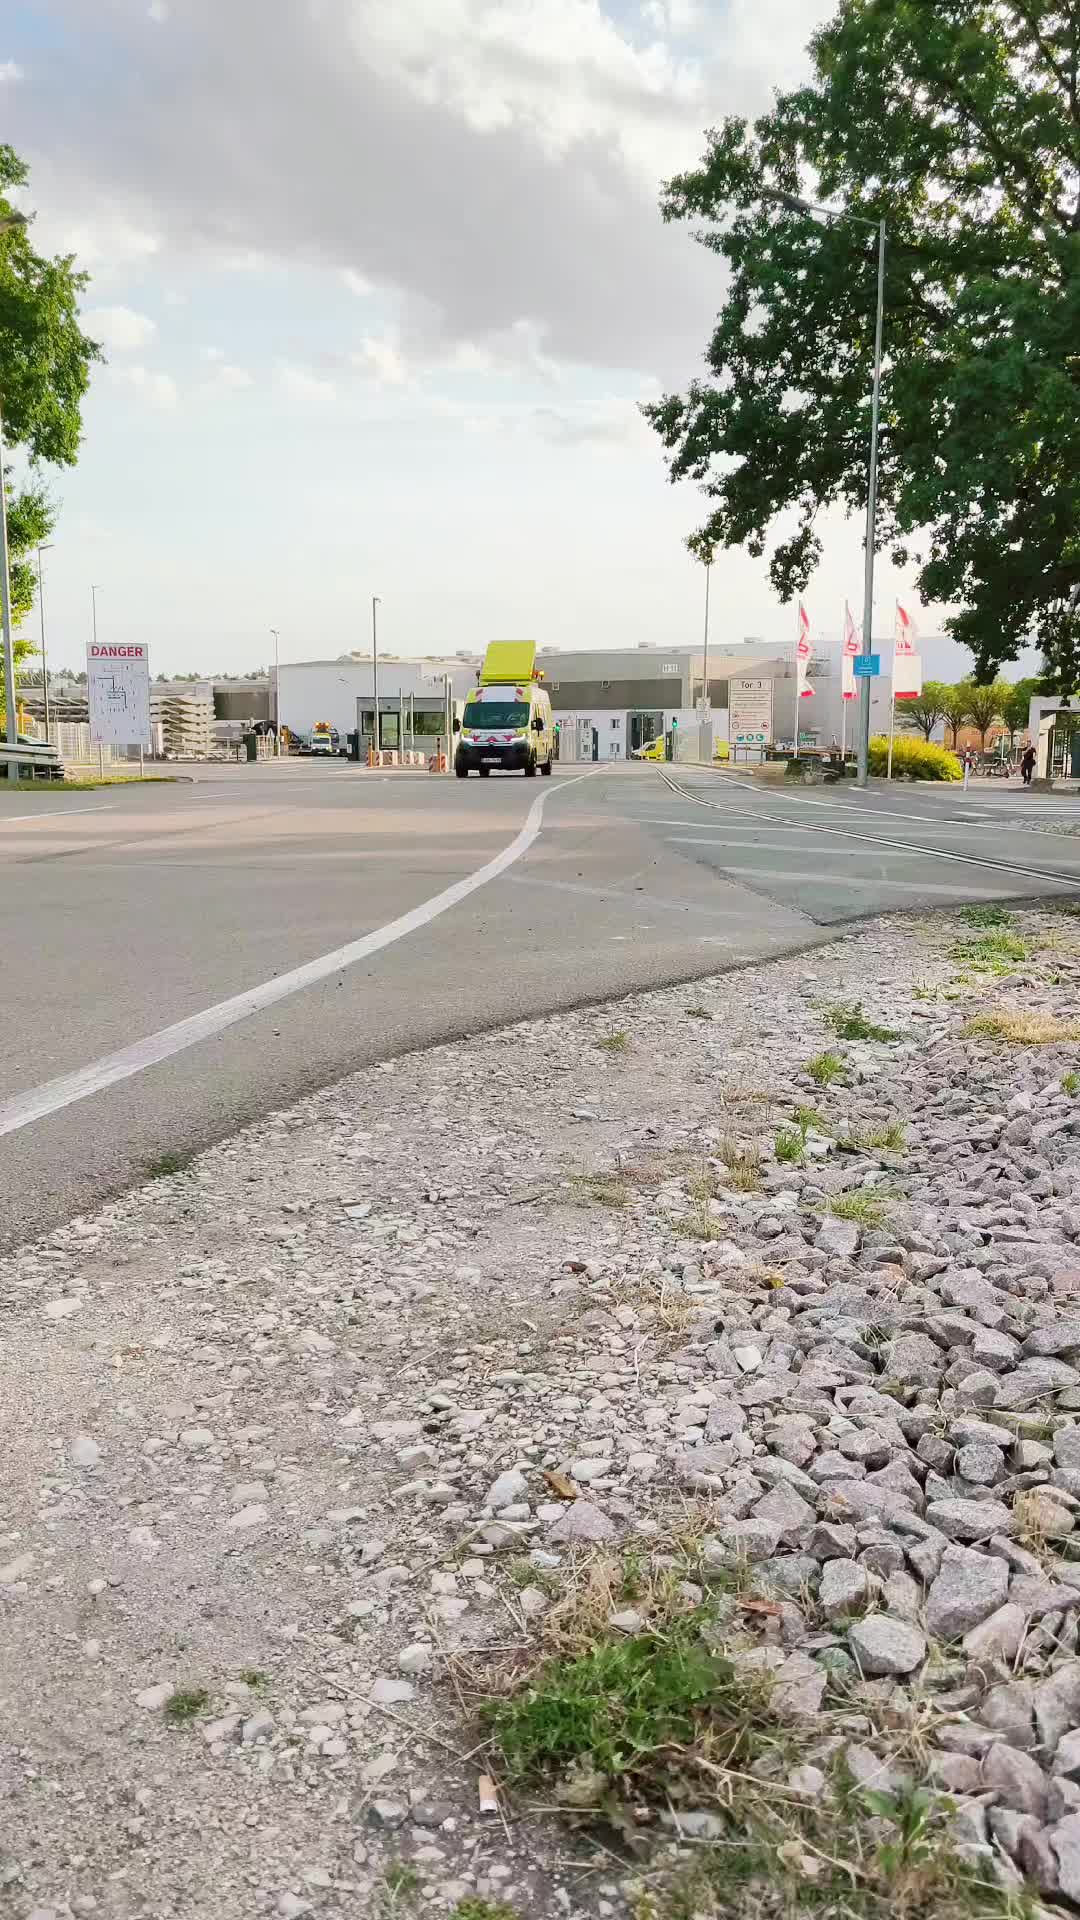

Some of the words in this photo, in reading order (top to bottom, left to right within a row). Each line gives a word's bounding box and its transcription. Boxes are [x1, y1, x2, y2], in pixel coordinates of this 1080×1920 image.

[91, 646, 143, 657] DANGER
[741, 681, 753, 689] Tor
[757, 681, 762, 689] 3
